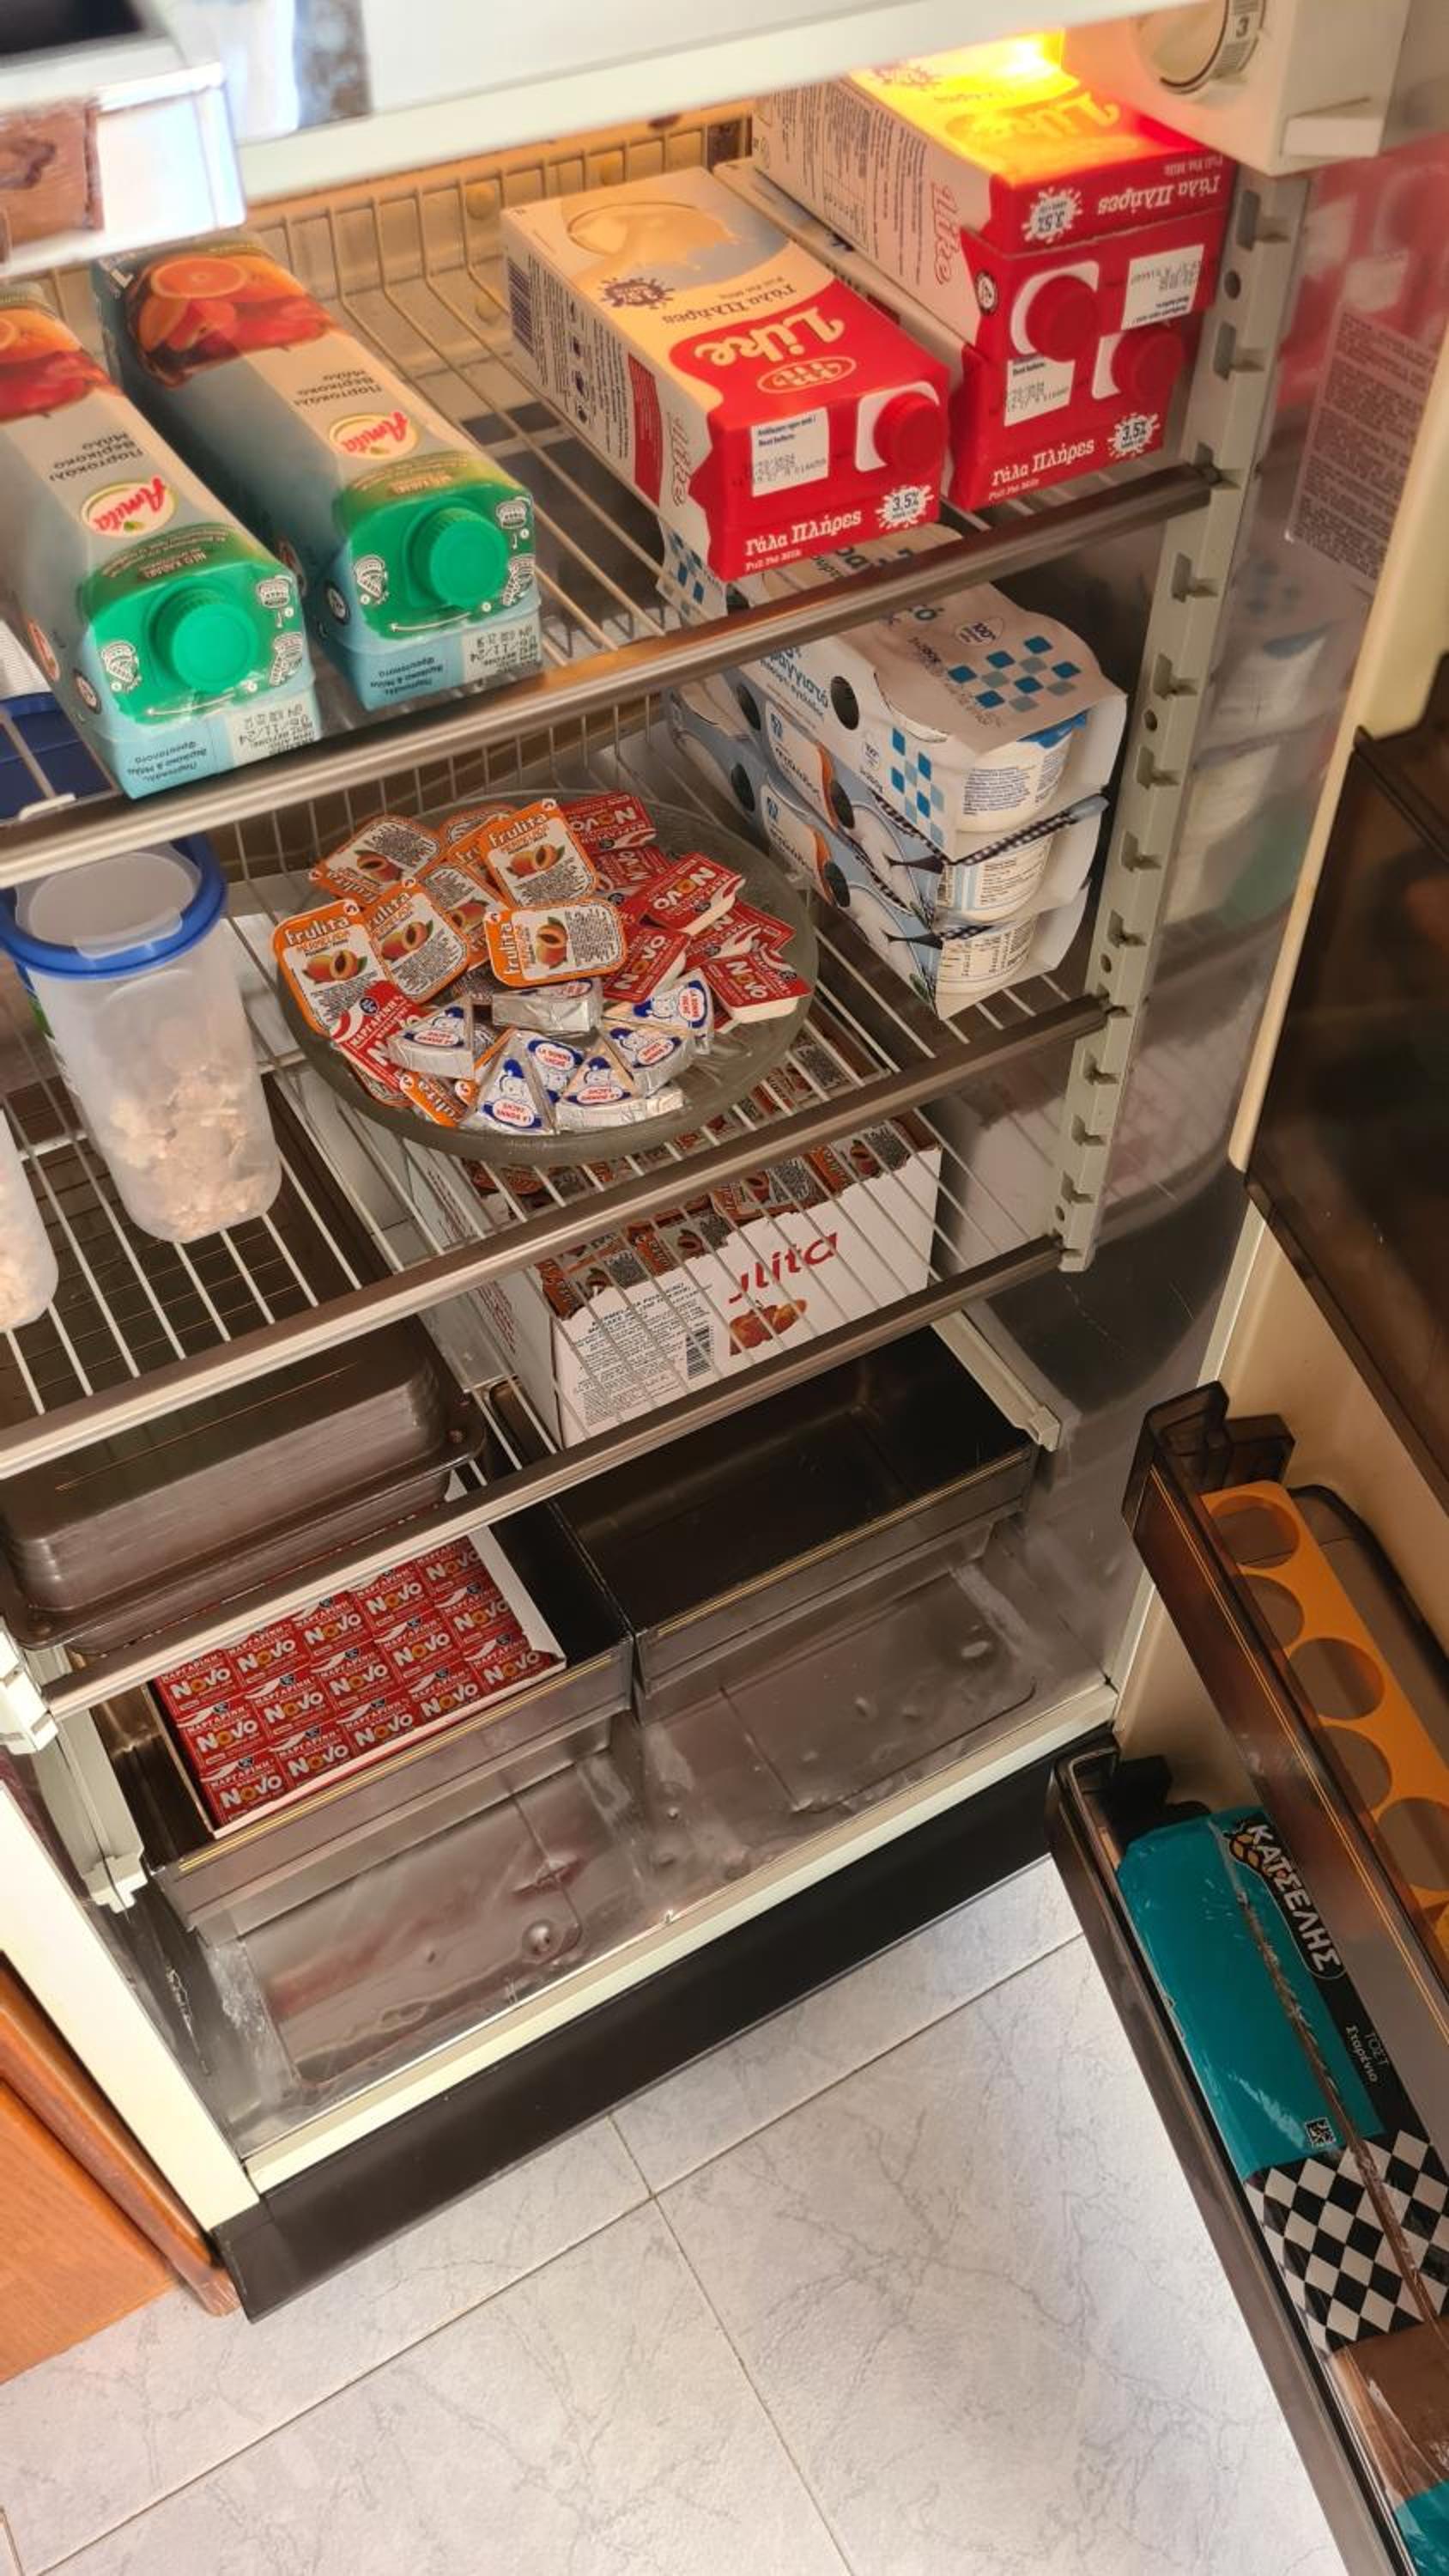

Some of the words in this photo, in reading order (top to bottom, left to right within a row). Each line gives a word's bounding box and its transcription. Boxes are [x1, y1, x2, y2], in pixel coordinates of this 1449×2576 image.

[1235, 16, 1250, 38] 3
[1098, 184, 1175, 215] Πλήρες
[1179, 174, 1221, 197] Γάλα
[662, 299, 747, 325] Πλήρες
[694, 306, 846, 367] Like
[341, 407, 410, 454] Amita
[1121, 420, 1149, 442] 3.5%
[48, 447, 144, 483] Πορτοκάλι
[53, 440, 135, 470] Βερίκοκο
[991, 464, 1029, 486] Γάλα
[1032, 439, 1094, 473] Πλήρες
[93, 477, 167, 532] Amita
[892, 491, 919, 511] 3.5%
[745, 532, 788, 556] Γάλα
[791, 510, 862, 545] Πλήρες
[488, 811, 549, 850] frulita
[284, 912, 351, 945] frulita
[367, 890, 411, 930] ulita
[502, 922, 521, 977] frulita
[729, 1231, 838, 1303] lita
[1247, 1822, 1343, 1974] ΚΑΤΣΕΛΗΣ
[1345, 2024, 1378, 2084] Σταρένιο
[1363, 2027, 1389, 2066] ΤΟΣΤ
